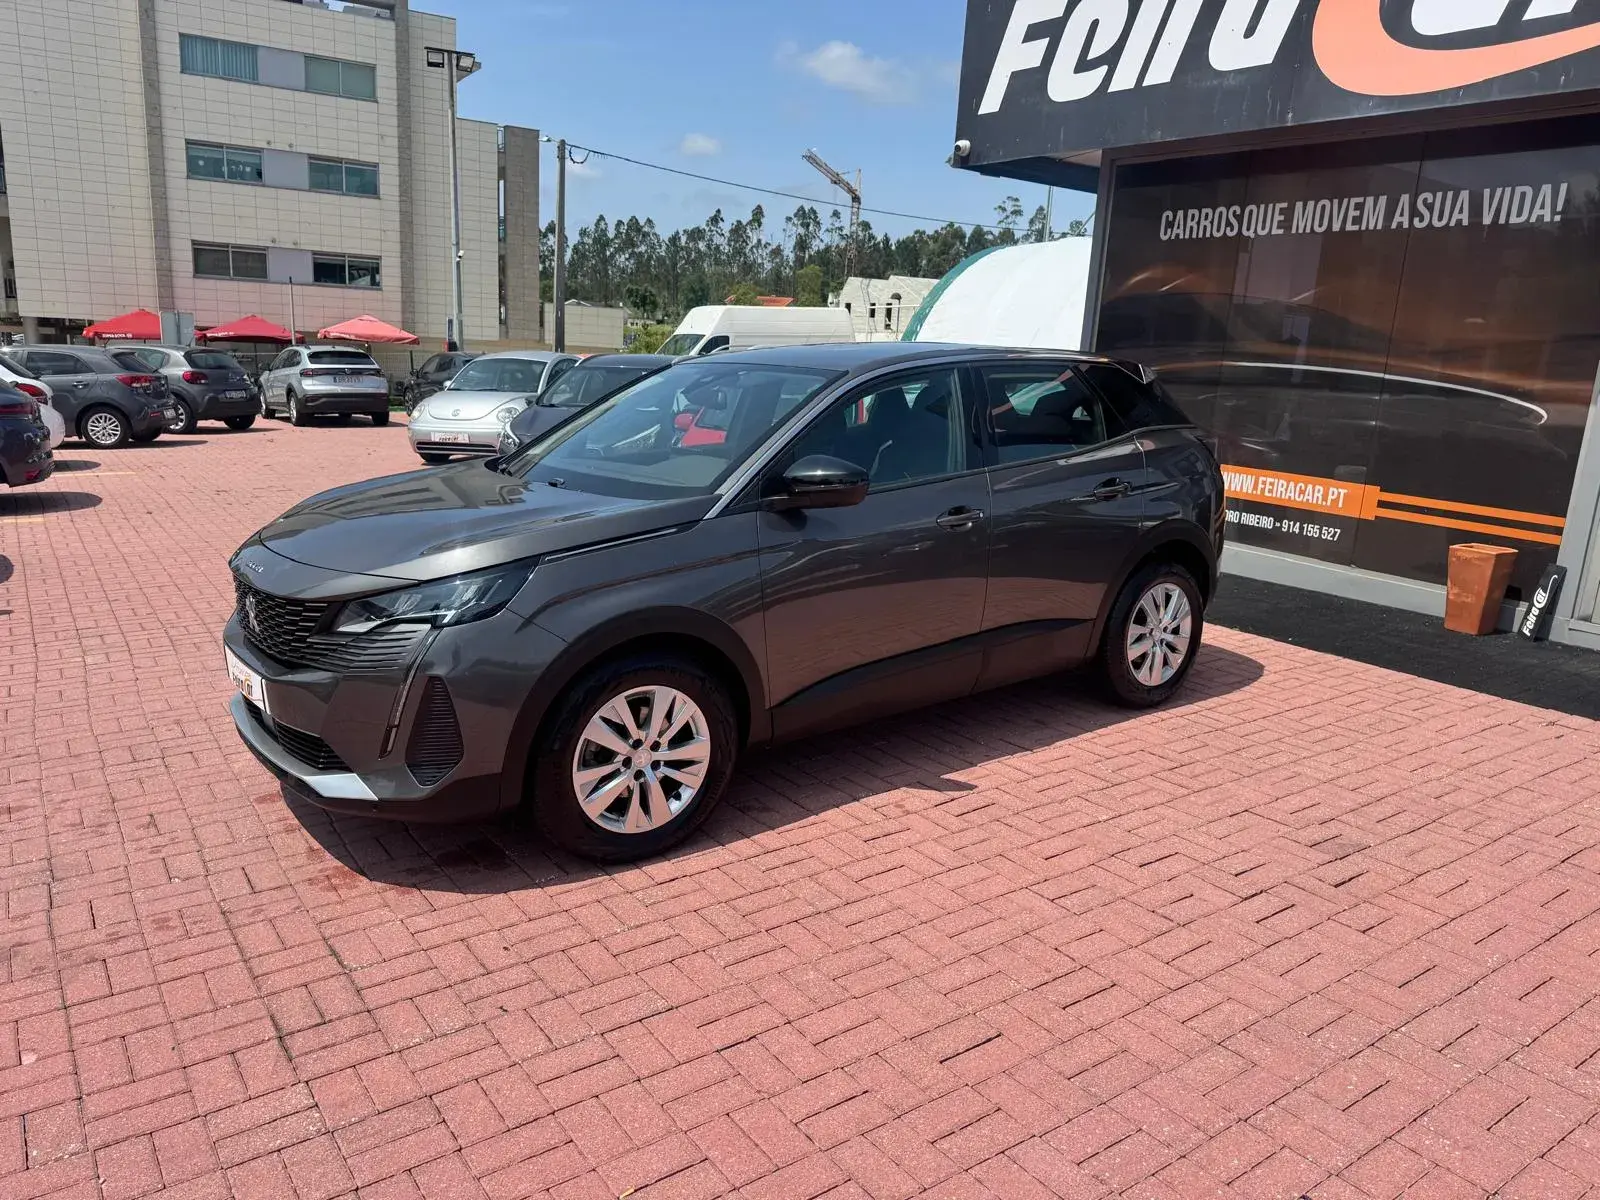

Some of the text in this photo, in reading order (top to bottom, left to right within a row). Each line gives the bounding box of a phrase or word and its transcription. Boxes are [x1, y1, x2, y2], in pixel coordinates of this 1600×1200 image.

[1159, 182, 1569, 241] CARROS QUE MOVEM A SUA VIDA!
[1240, 512, 1274, 529] RIBEIRO
[1281, 519, 1300, 535] 914
[1302, 523, 1321, 538] 155
[1321, 526, 1341, 542] 527
